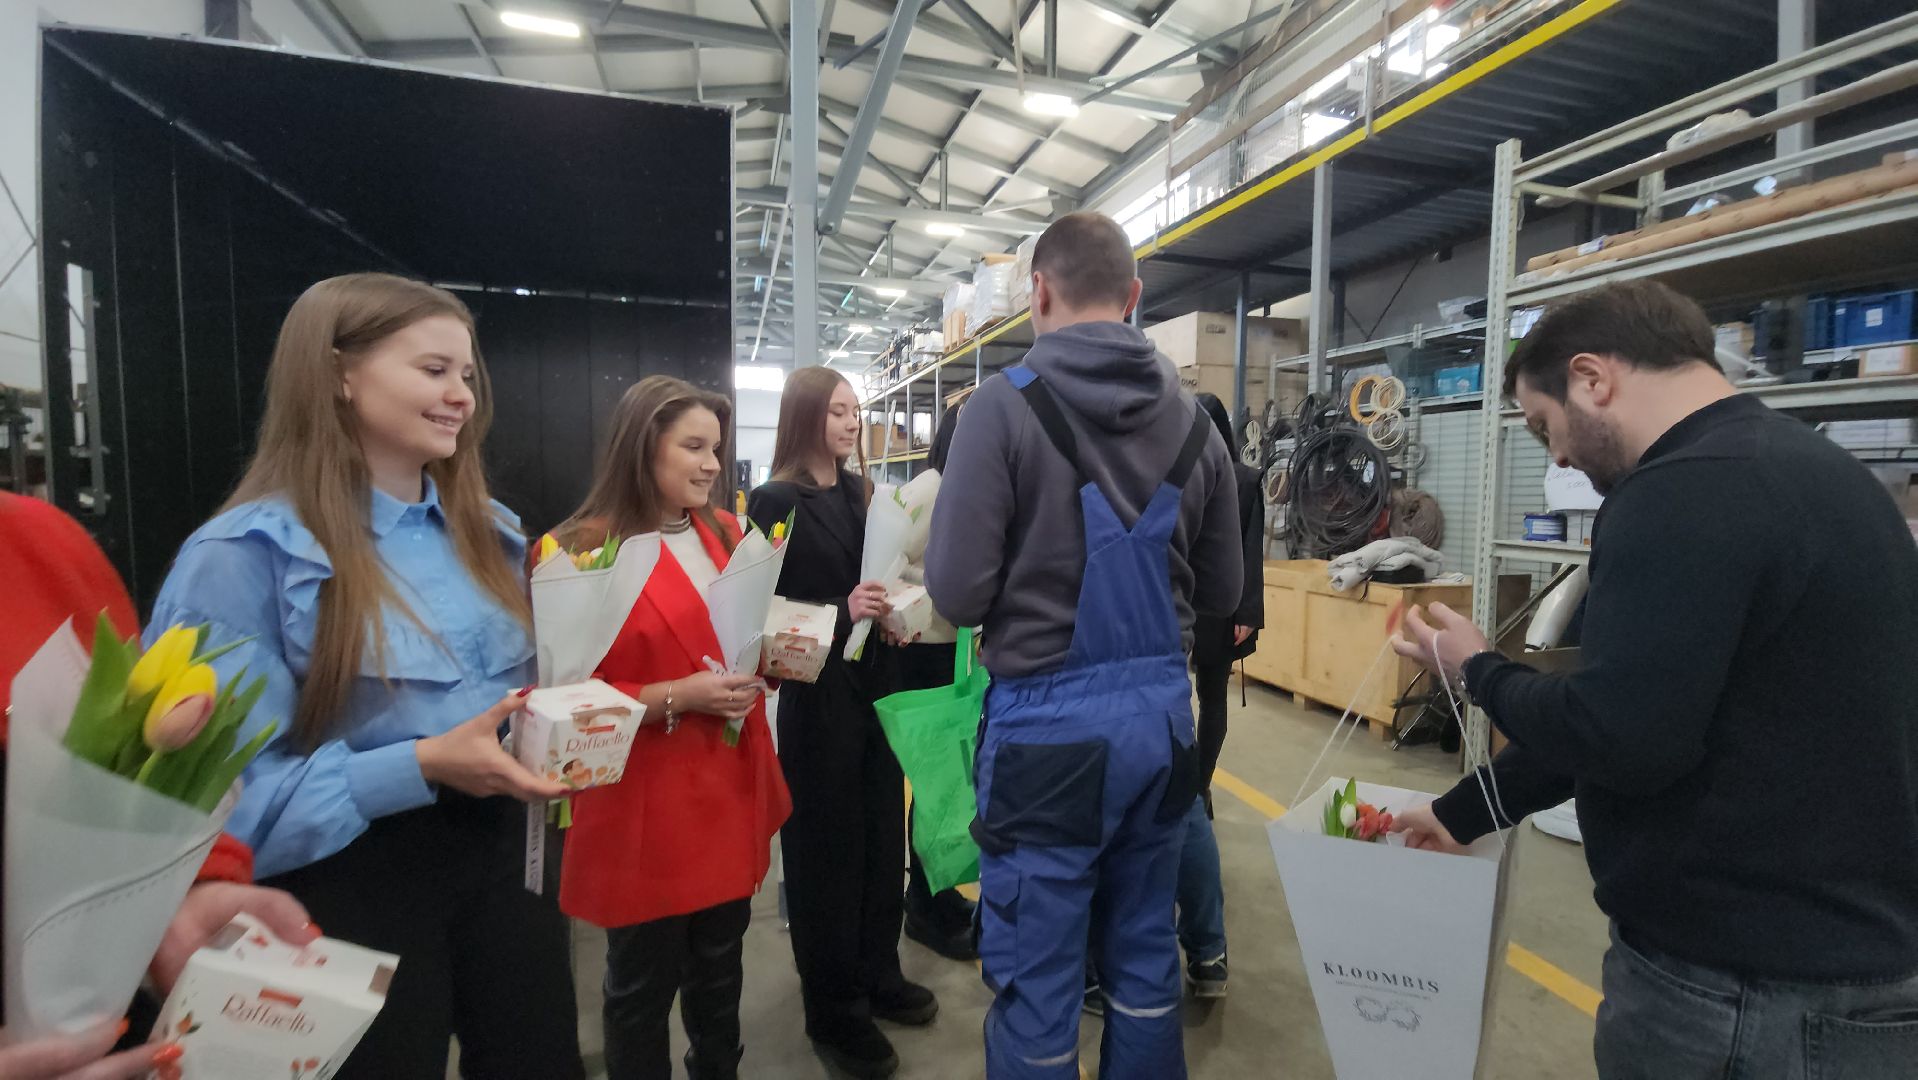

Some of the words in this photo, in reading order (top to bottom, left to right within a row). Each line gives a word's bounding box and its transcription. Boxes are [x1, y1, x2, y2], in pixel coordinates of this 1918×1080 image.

[771, 648, 819, 663] Raffaello
[565, 732, 630, 753] Raffaello
[1322, 961, 1439, 993] KLOOMBIS
[221, 994, 316, 1034] Raffaello
